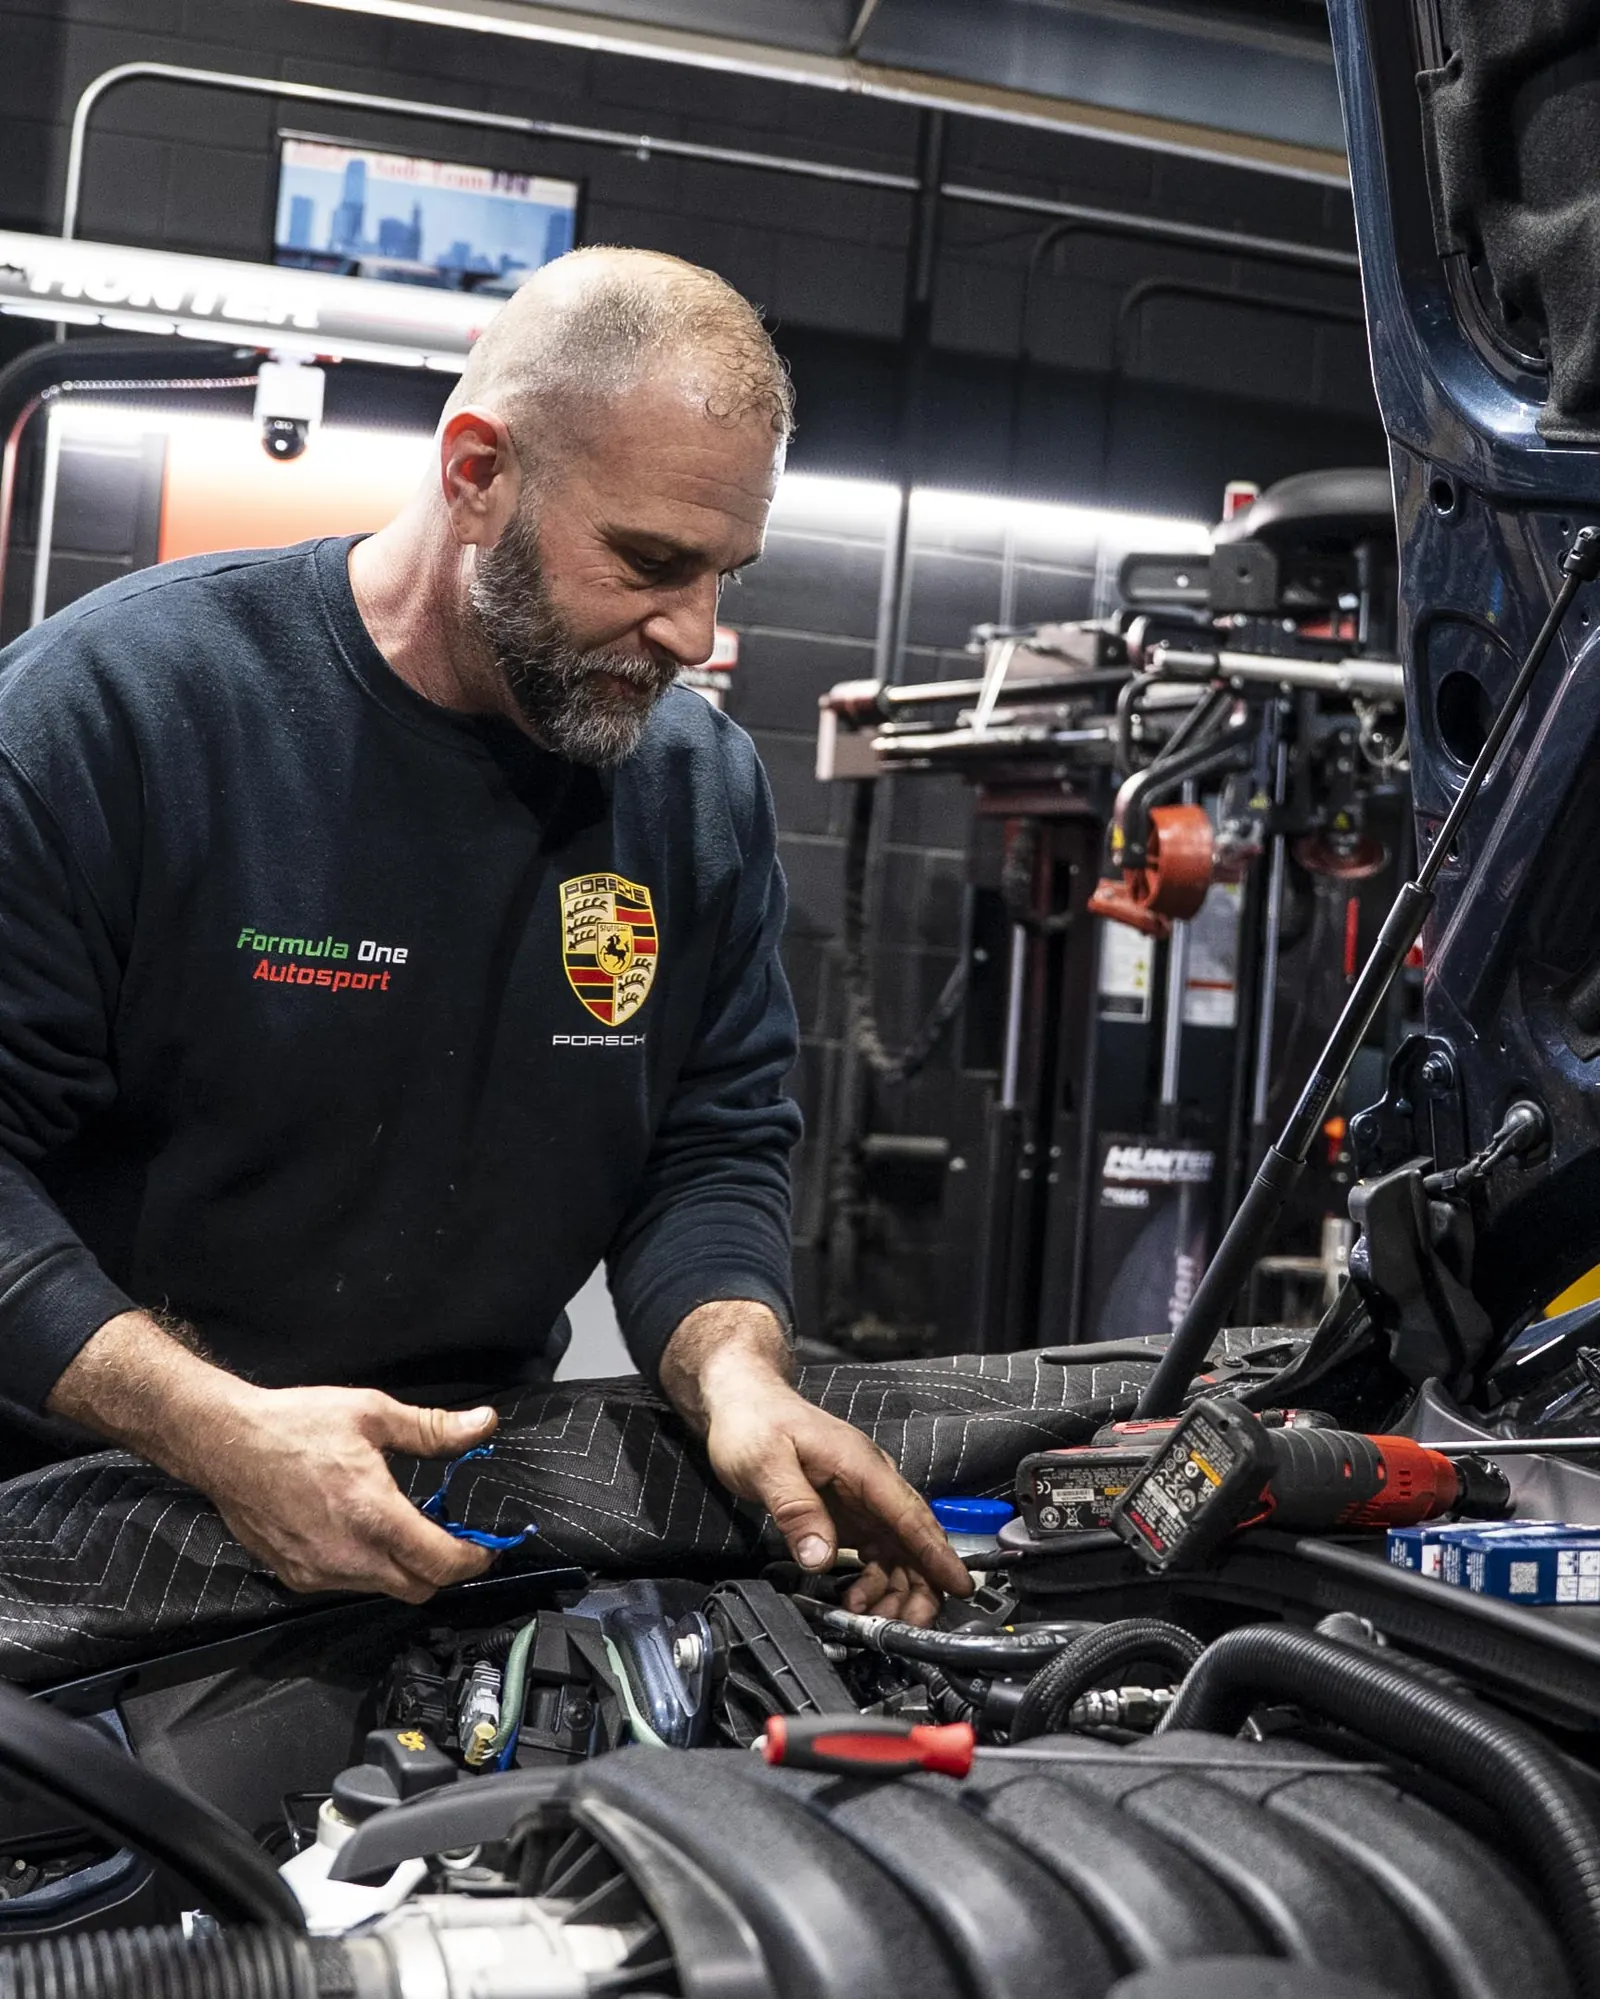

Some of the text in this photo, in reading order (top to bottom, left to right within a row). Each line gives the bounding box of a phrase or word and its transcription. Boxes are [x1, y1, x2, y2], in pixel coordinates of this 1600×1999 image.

[236, 928, 409, 964] Formula One
[252, 959, 392, 993] Autosport
[552, 1033, 647, 1046] PORSCH
